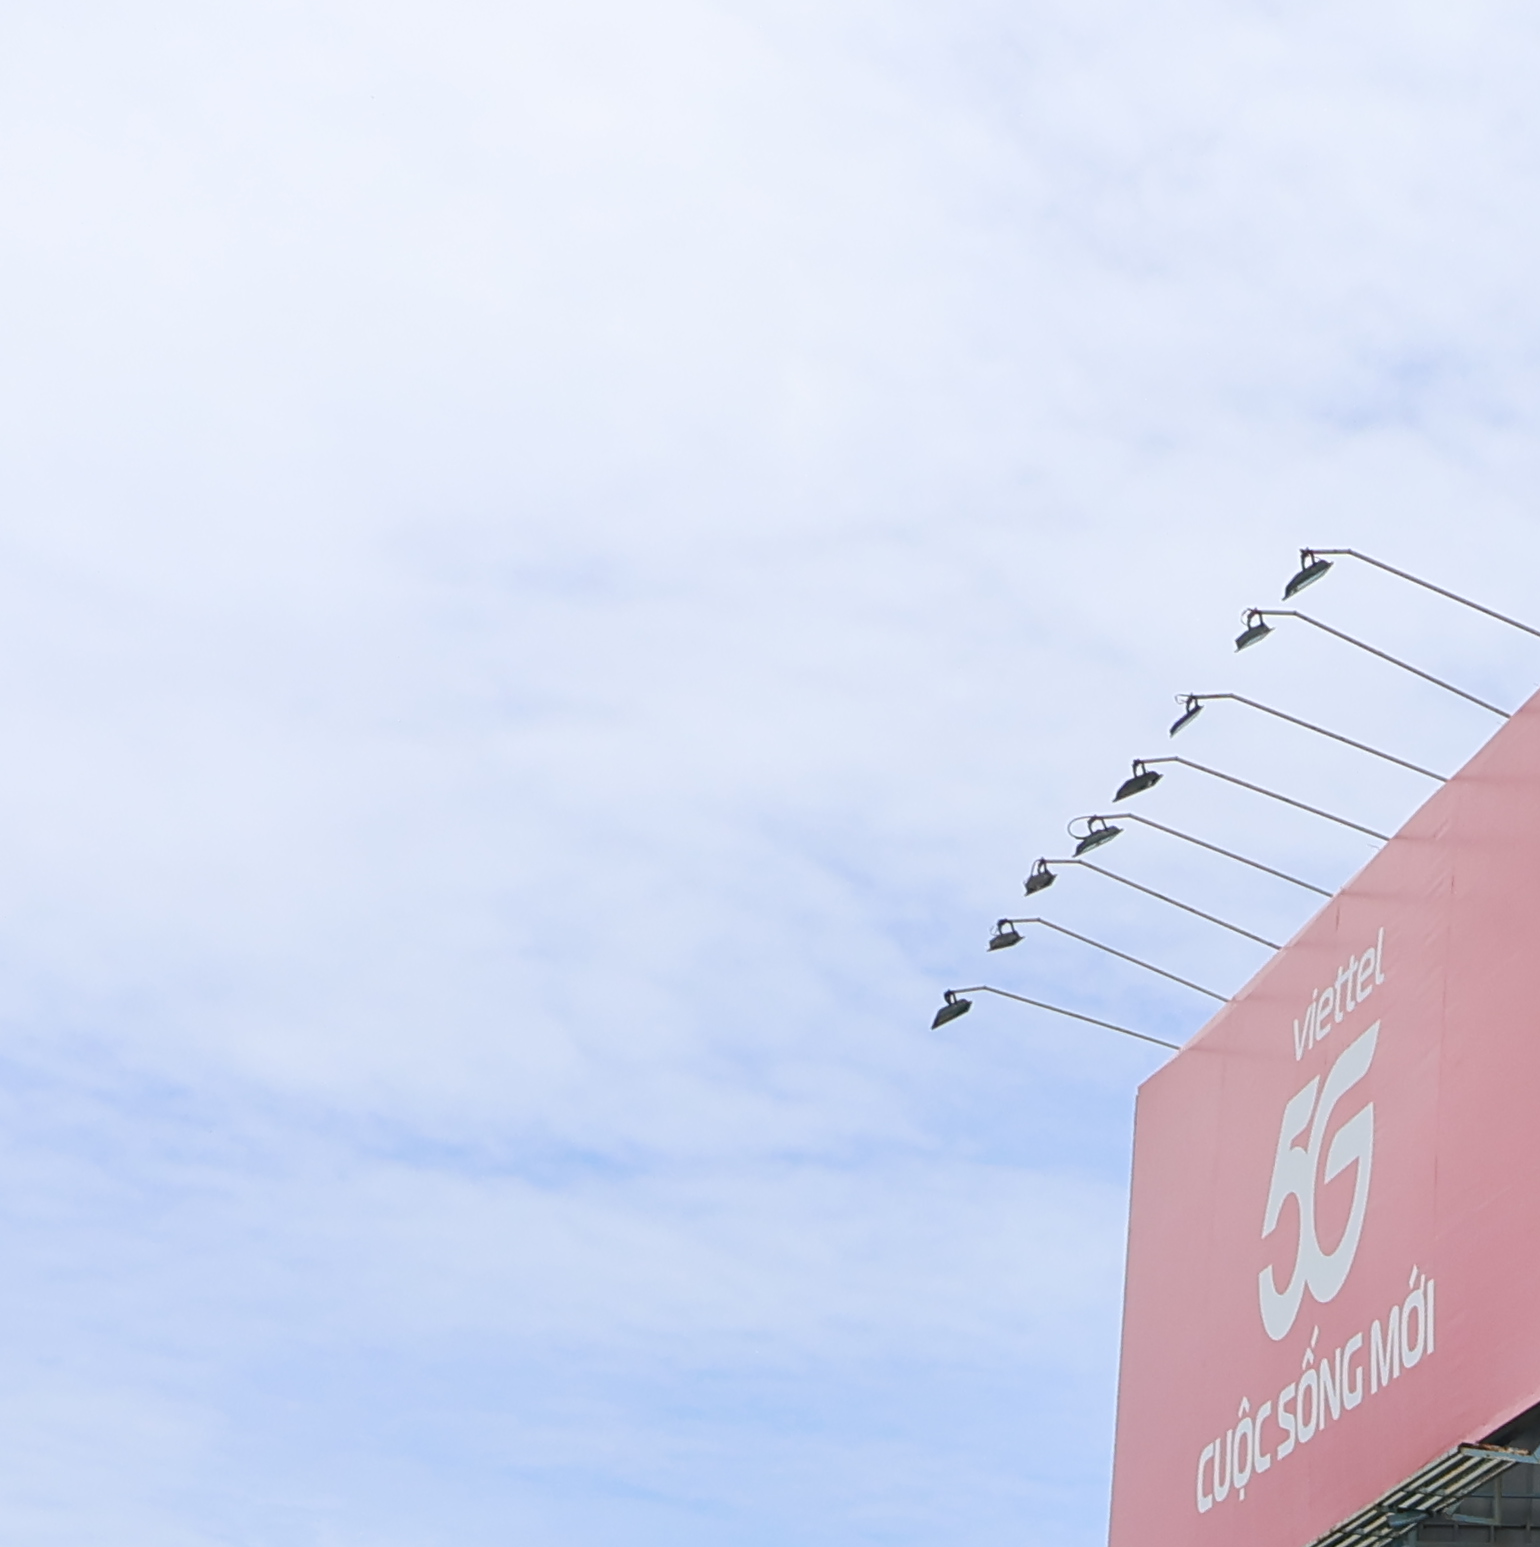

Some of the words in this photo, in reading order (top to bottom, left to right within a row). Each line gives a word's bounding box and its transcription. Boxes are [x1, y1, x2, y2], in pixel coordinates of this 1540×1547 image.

[1293, 927, 1385, 1061] viettel
[1259, 1019, 1381, 1341] 5G
[1195, 1397, 1272, 1514] CUỘC
[1276, 1325, 1362, 1461] SỐNG
[1370, 1265, 1435, 1394] MỚI
